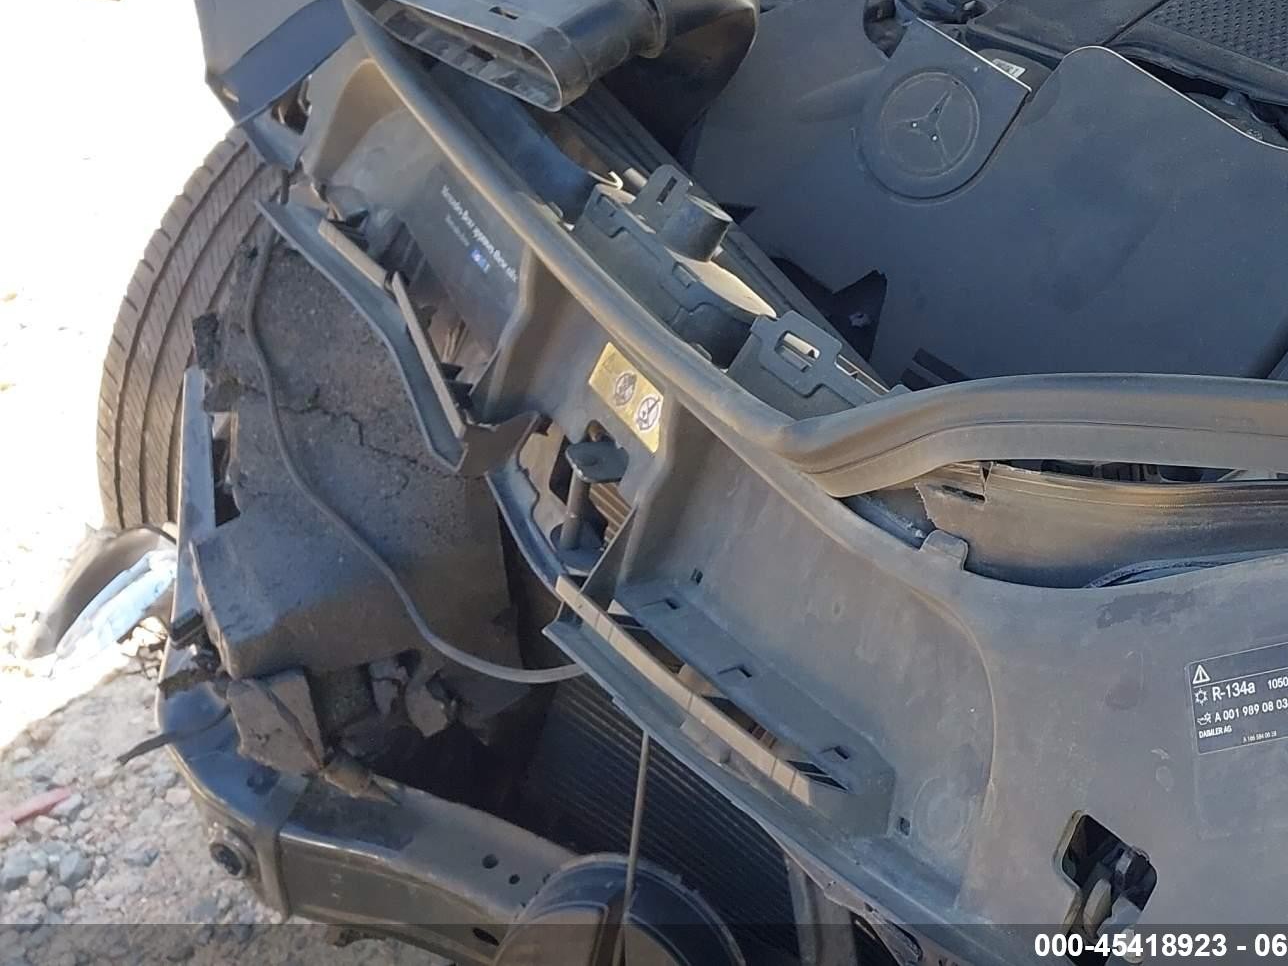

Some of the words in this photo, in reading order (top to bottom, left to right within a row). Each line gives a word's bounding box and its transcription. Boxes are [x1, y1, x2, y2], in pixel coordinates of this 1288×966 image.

[1212, 681, 1256, 702] R-134a
[1267, 676, 1288, 690] 1050
[1214, 712, 1222, 723] A
[1223, 708, 1240, 720] 001
[1242, 704, 1260, 716] 989
[1262, 701, 1274, 712] 08
[1276, 698, 1288, 709] 03
[1198, 727, 1223, 739] DAIMLER
[1223, 725, 1232, 735] AG
